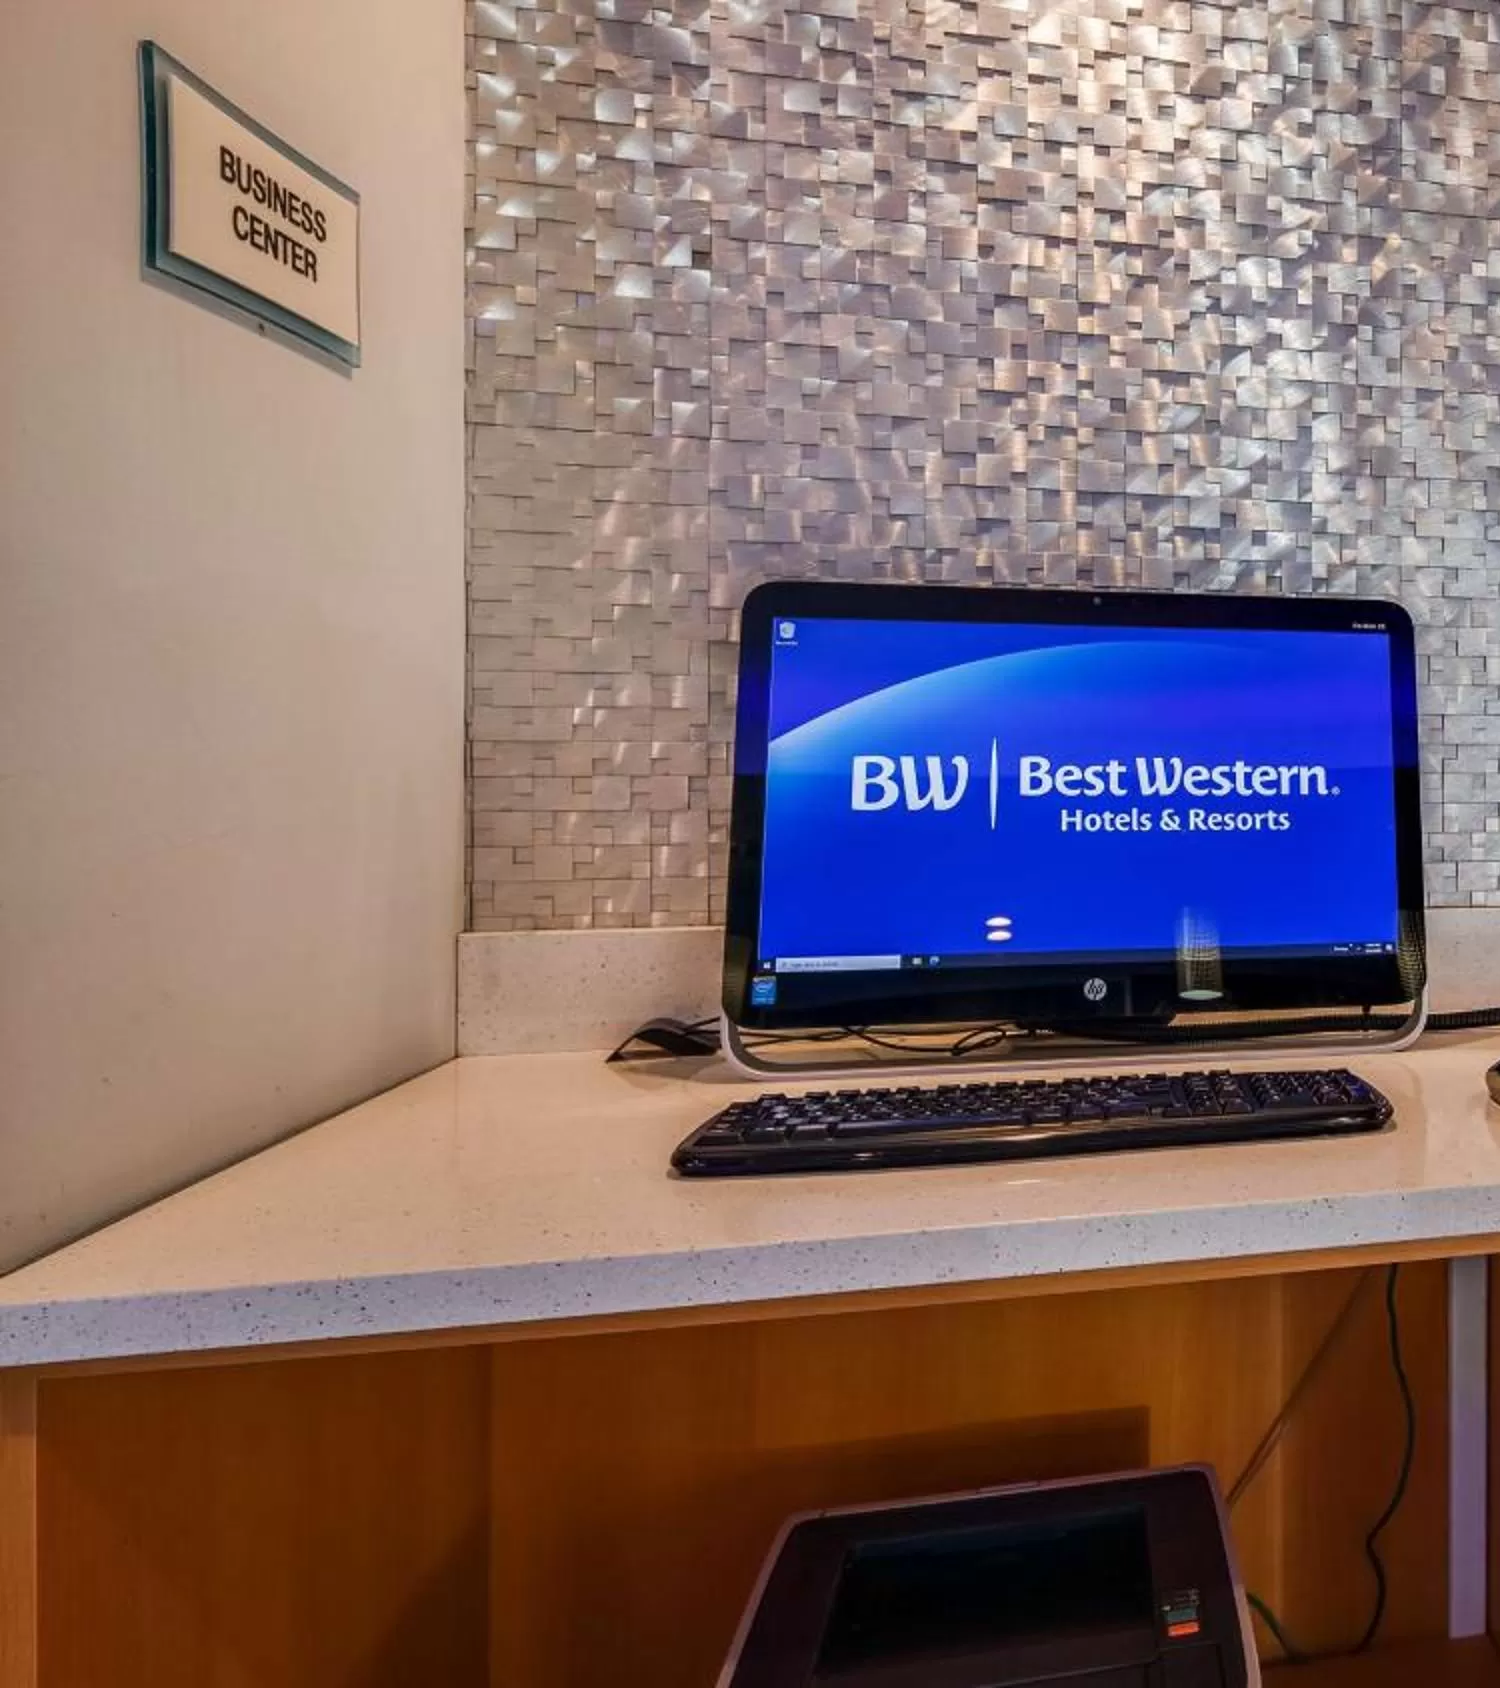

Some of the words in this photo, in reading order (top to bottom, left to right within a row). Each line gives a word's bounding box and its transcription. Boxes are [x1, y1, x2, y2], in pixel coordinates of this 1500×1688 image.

[219, 145, 327, 243] BUSINESS
[232, 205, 318, 283] CENTER
[851, 755, 969, 811] BW
[1019, 755, 1127, 797] Best
[1135, 756, 1329, 797] Western
[1061, 807, 1153, 832] Hotels
[1159, 809, 1181, 832] &
[1189, 808, 1290, 831] Resorts
